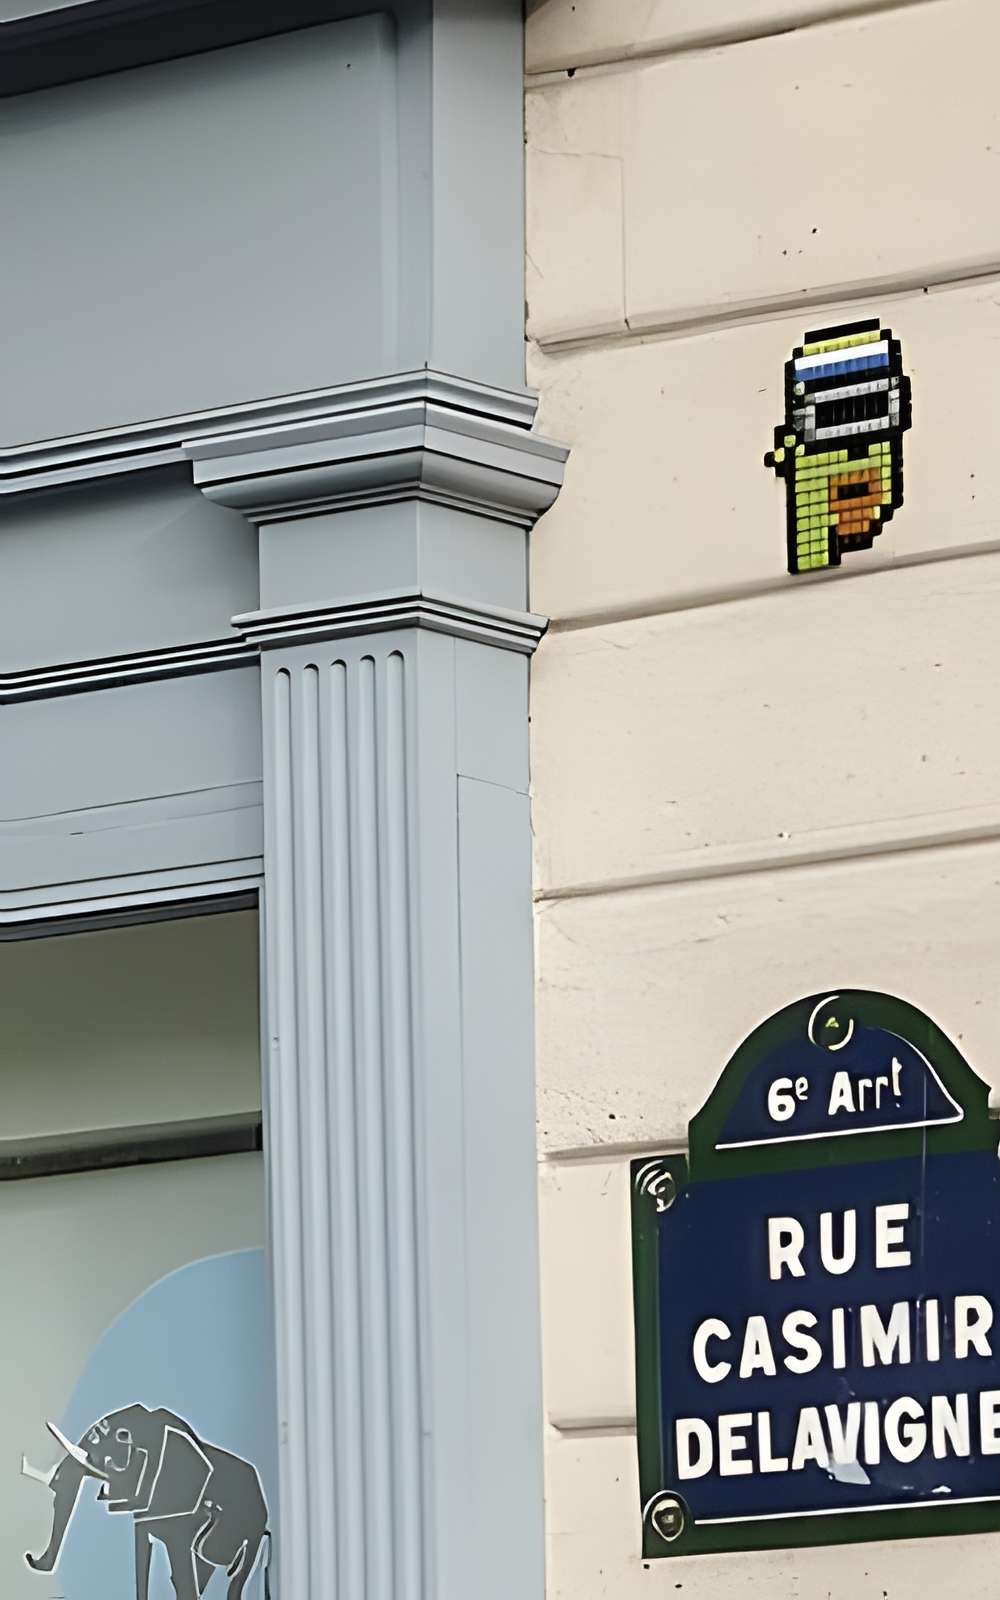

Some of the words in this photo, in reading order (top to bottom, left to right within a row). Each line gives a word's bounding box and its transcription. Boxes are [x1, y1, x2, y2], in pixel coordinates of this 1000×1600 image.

[767, 1077, 809, 1121] 6e
[767, 1203, 911, 1280] RUE
[693, 1295, 993, 1383] CASIMIR
